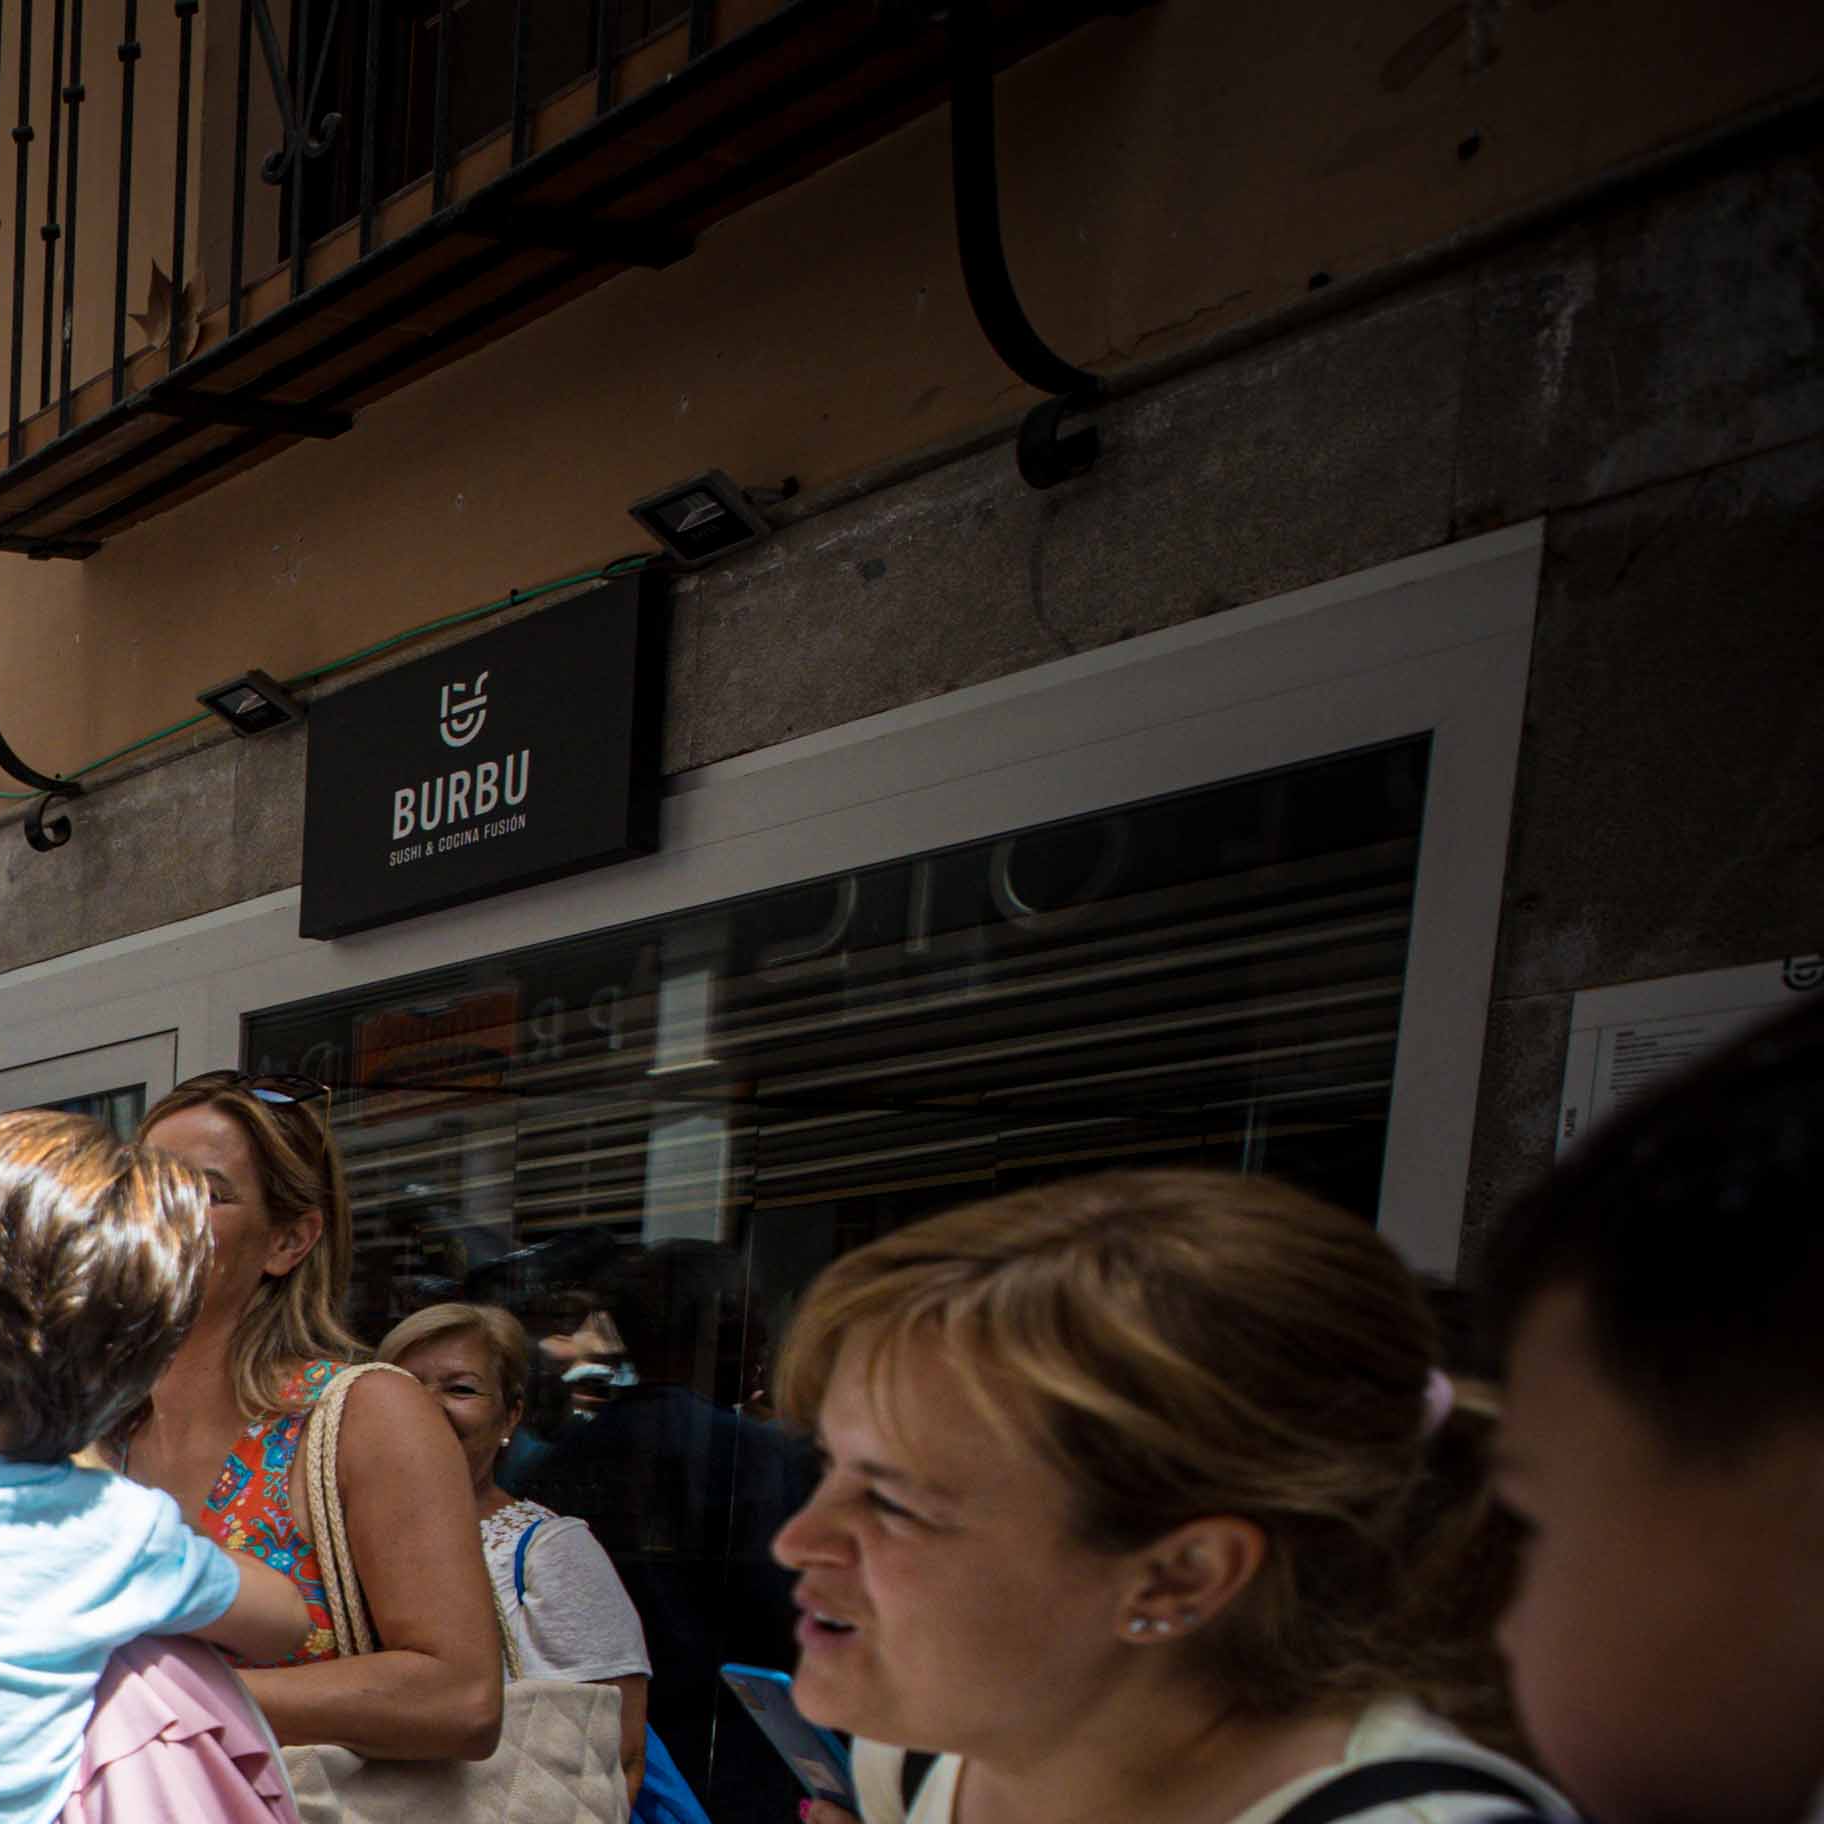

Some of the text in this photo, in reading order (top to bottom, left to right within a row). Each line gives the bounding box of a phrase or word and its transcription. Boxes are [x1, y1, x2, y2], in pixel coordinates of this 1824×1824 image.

[392, 749, 530, 840] BURBU
[389, 814, 527, 867] SUSHI & COCINA FUSIÓN
